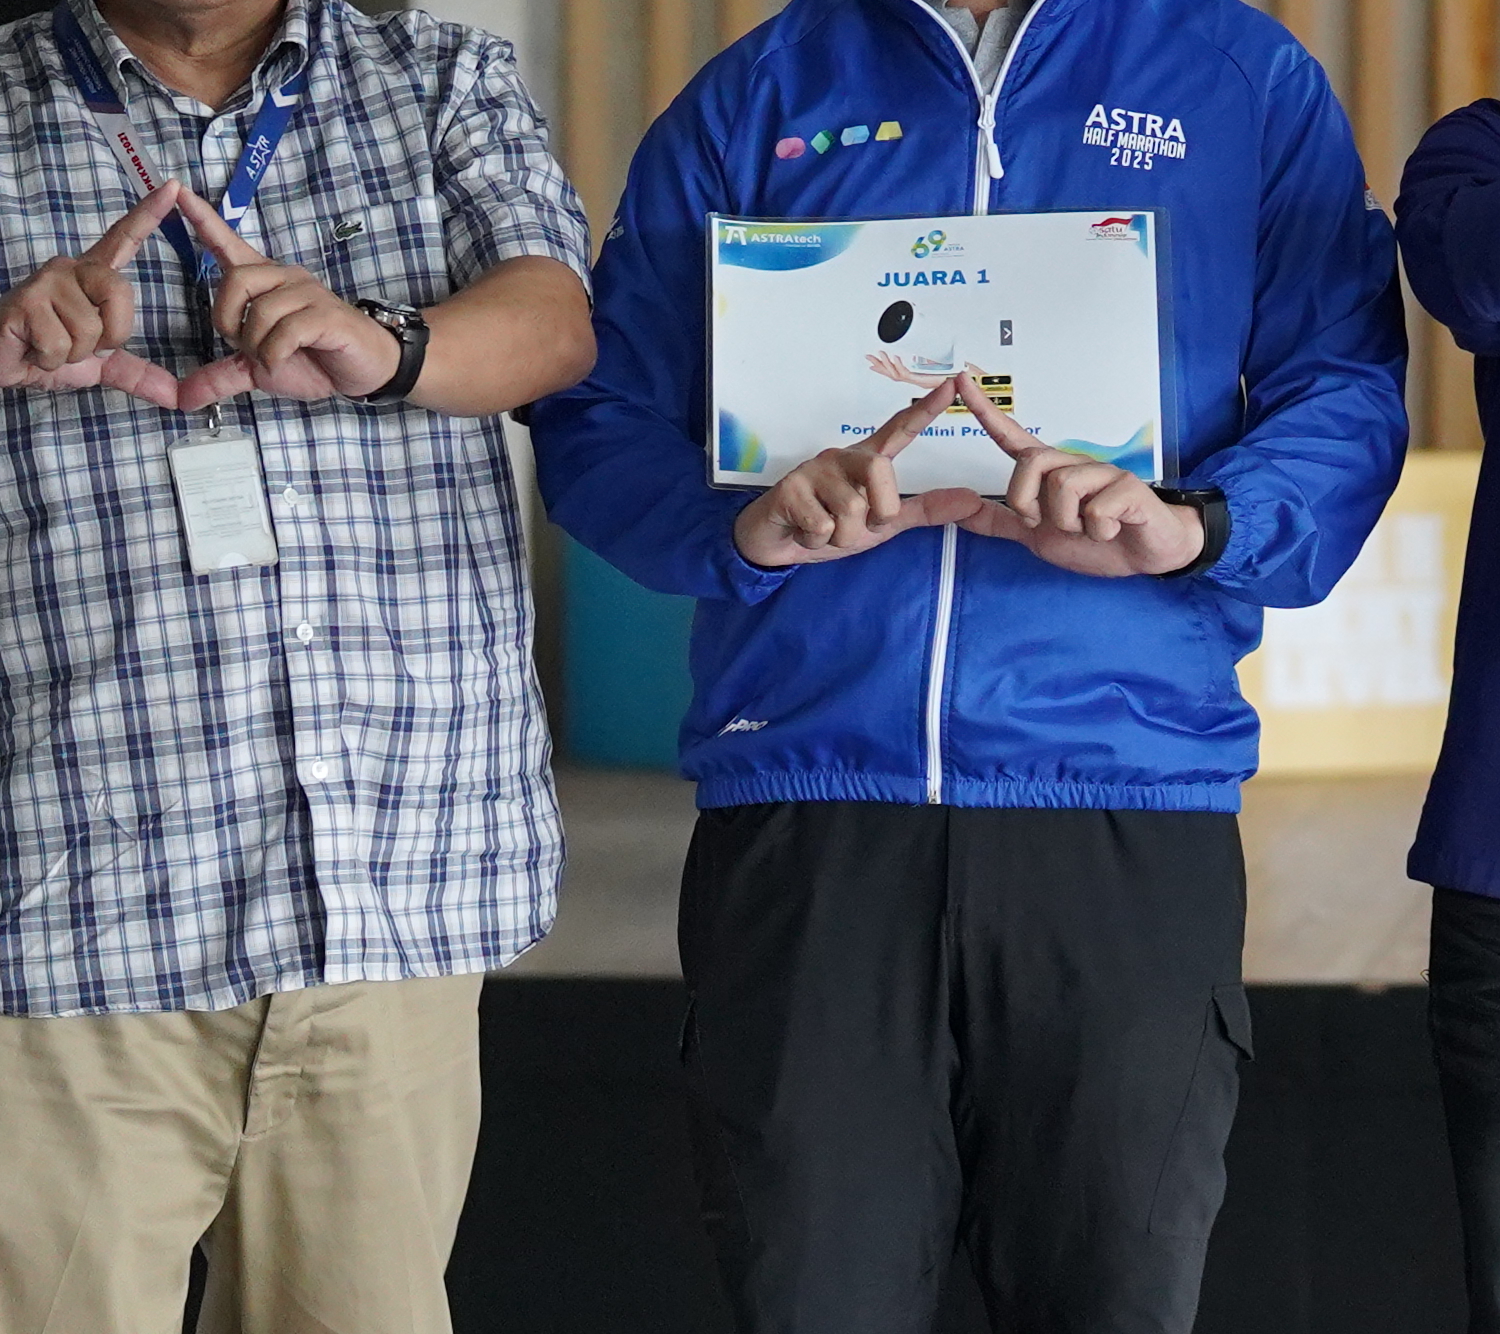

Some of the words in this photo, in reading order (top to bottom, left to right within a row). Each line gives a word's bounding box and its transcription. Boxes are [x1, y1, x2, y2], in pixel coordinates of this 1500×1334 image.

[1085, 104, 1186, 142] ASTRA
[117, 132, 136, 155] 2021
[1083, 127, 1116, 147] HALF
[1117, 131, 1186, 159] MARATHON
[1110, 148, 1154, 170] 2025
[131, 153, 155, 190] PKKMB
[751, 233, 821, 244] ASTRAtech
[911, 230, 947, 258] 69
[877, 270, 967, 287] JUARA
[977, 269, 990, 284] 1
[920, 426, 954, 436] Mini
[961, 425, 1041, 439] Proor
